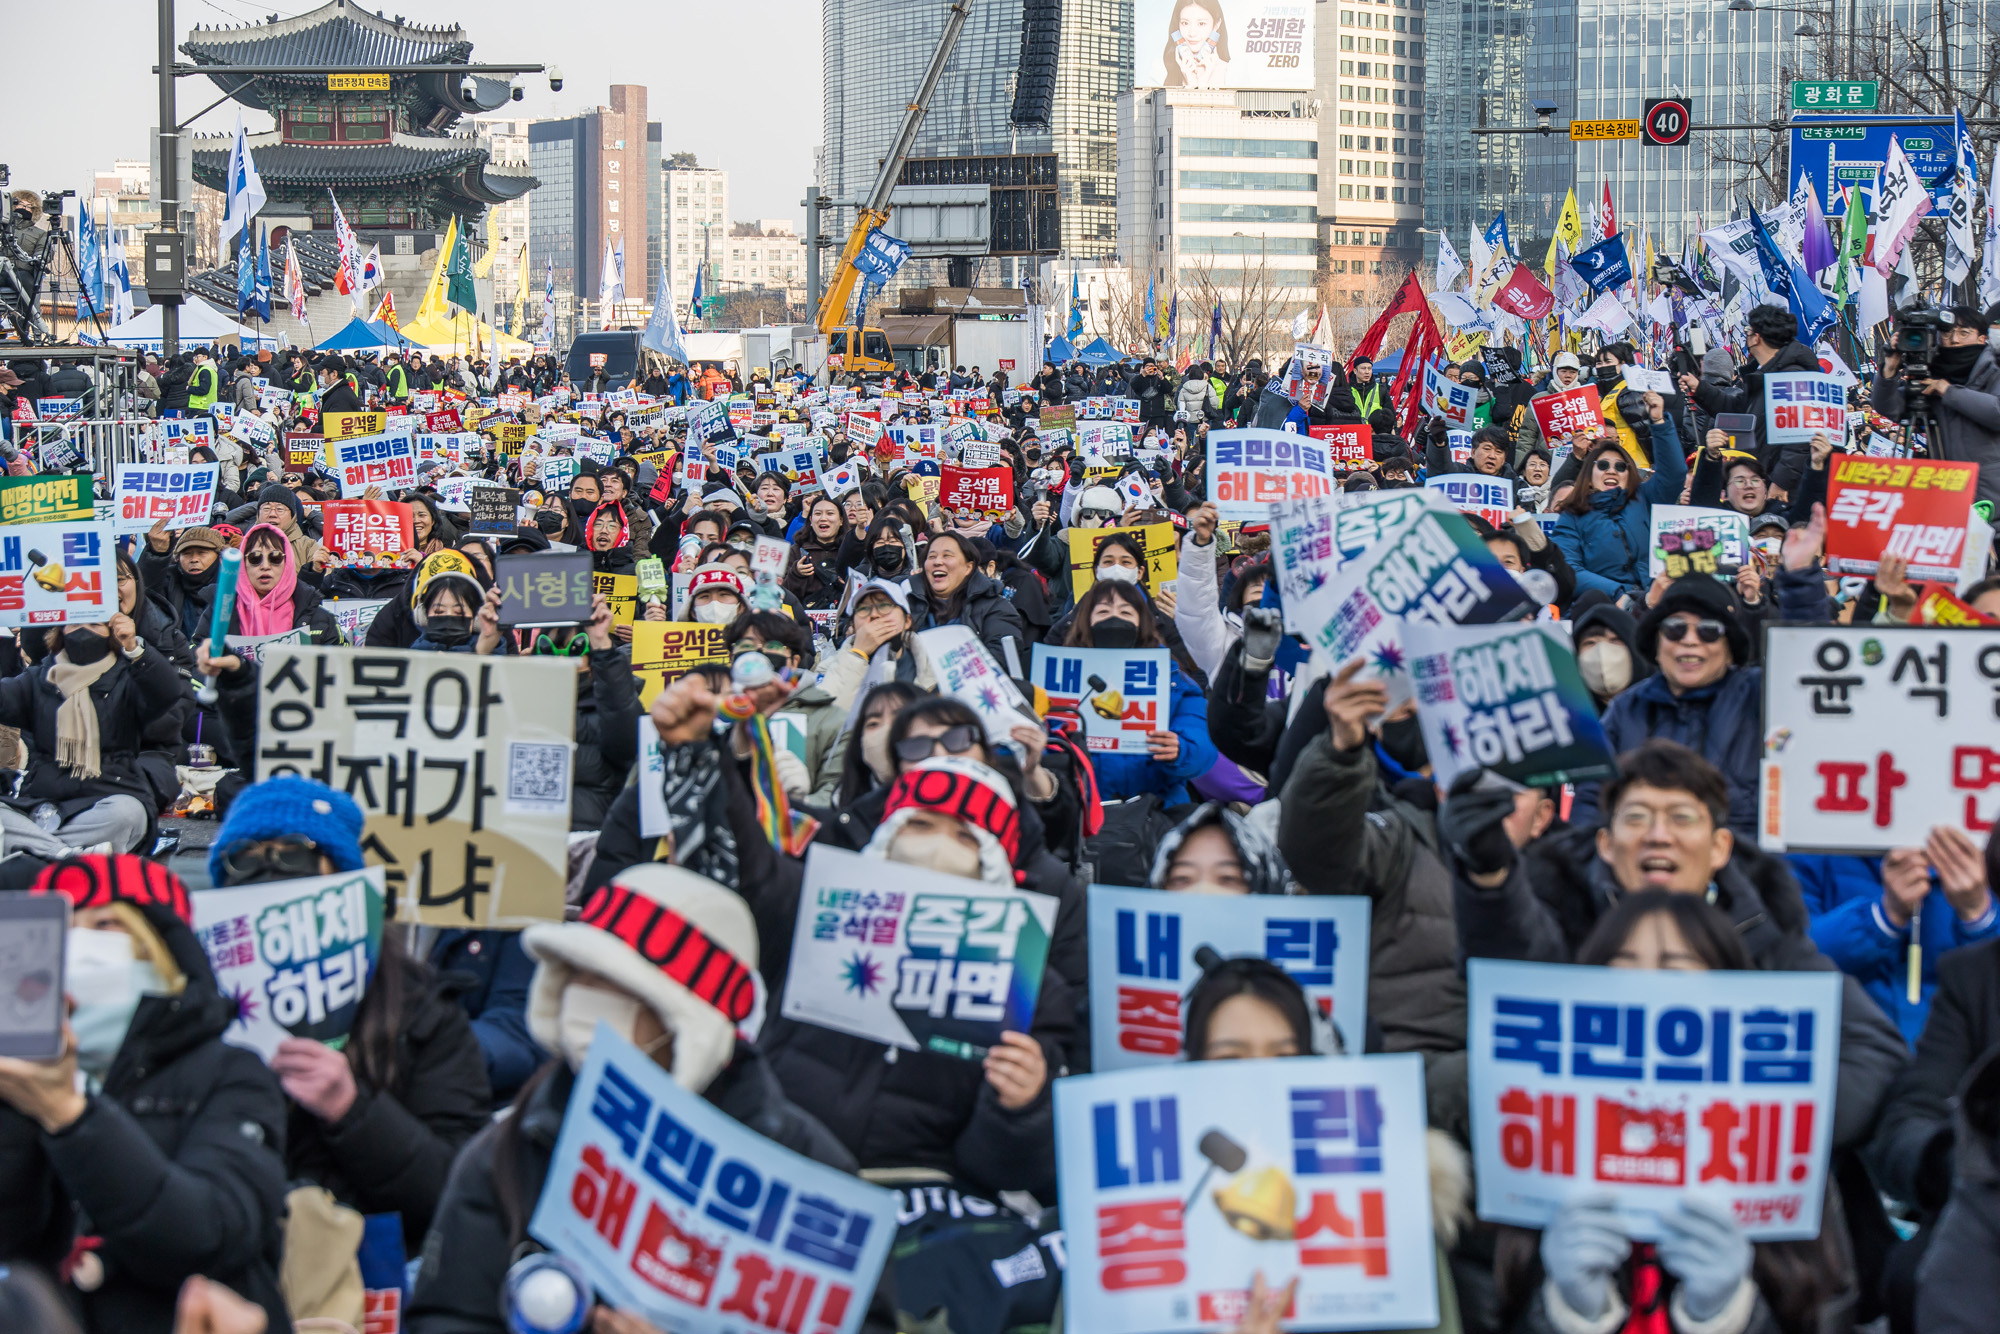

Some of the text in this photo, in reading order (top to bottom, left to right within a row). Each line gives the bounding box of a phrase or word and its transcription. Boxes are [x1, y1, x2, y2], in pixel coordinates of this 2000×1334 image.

[1245, 41, 1302, 54] BOOSTER
[1267, 55, 1300, 68] ZERO
[330, 78, 389, 88] 불법주정차 단속중
[1804, 86, 1864, 104] 광화문
[1574, 122, 1637, 138] 과속단속장비
[1656, 113, 1680, 133] 40
[1908, 140, 1931, 149] 시청
[1906, 153, 1948, 163] 종대로
[1450, 386, 1469, 407] 란
[1772, 380, 1843, 405] 국민의힘
[40, 402, 81, 413] 국민의힘
[699, 402, 724, 424] 체포!
[1550, 396, 1589, 419] 윤석열
[1774, 405, 1845, 431] 해 체!
[194, 422, 209, 435] 란
[341, 413, 377, 435] 윤석열
[502, 426, 526, 437] 윤석열
[703, 419, 729, 438] 구속!
[1548, 408, 1597, 434] 즉각 파면
[420, 437, 459, 450] 내 란
[889, 428, 935, 445] 내 란
[1103, 425, 1130, 442] 즉각
[1324, 432, 1358, 446] 윤석열
[340, 436, 409, 463] 국민의힘
[502, 440, 526, 456] 파면
[591, 443, 614, 455] 해체
[687, 446, 736, 468] 국의힘
[921, 444, 936, 459] 식
[1102, 441, 1130, 456] 파면
[1216, 439, 1326, 473] 국민의힘
[1330, 445, 1365, 459] 각 파면
[345, 456, 414, 486] 해 체!
[545, 458, 573, 476] 즉각
[687, 463, 703, 480] 해
[793, 451, 814, 471] 란
[122, 470, 214, 492] 국민의힘
[546, 473, 572, 491] 파면
[798, 470, 818, 486] 식
[958, 477, 1000, 494] 윤석열
[1217, 472, 1249, 501] 해
[1835, 460, 1972, 491] 내란수괴 윤석열
[1, 479, 79, 519] 생명안전
[122, 492, 211, 519] 해 체!
[948, 492, 1007, 510] 즉각 파면
[1830, 487, 1904, 529] 즉각
[333, 513, 401, 533] 특검으로
[1657, 516, 1695, 530] 내란수괴
[63, 532, 101, 567] 란
[333, 532, 402, 551] 내란 척결
[1886, 525, 1964, 565] 파면!
[757, 545, 783, 567] 탄핵
[1370, 522, 1460, 613] 해체
[64, 571, 103, 606] 식
[663, 628, 729, 660] 윤석열
[1046, 656, 1158, 695] 내 란
[1453, 633, 1556, 704] 해체
[265, 654, 503, 740] 상목아
[1121, 701, 1157, 734] 식
[1465, 694, 1575, 764] 하라
[816, 887, 905, 913] 내란수괴
[256, 876, 369, 966] 해체
[813, 911, 899, 945] 윤석열
[908, 894, 1027, 957] 즉각
[1115, 909, 1338, 987] 내 란
[266, 942, 369, 1027] 하라
[900, 955, 1014, 1020] 파면
[1116, 986, 1182, 1057] 종
[1493, 995, 1815, 1085] 국민의힘
[1092, 1086, 1386, 1190] 내 란
[1498, 1087, 1814, 1185] 해 체!
[588, 1063, 874, 1273] 국민의힘
[570, 1142, 856, 1334] 해 체!
[1096, 1199, 1187, 1292] 종
[1294, 1188, 1391, 1279] 식
